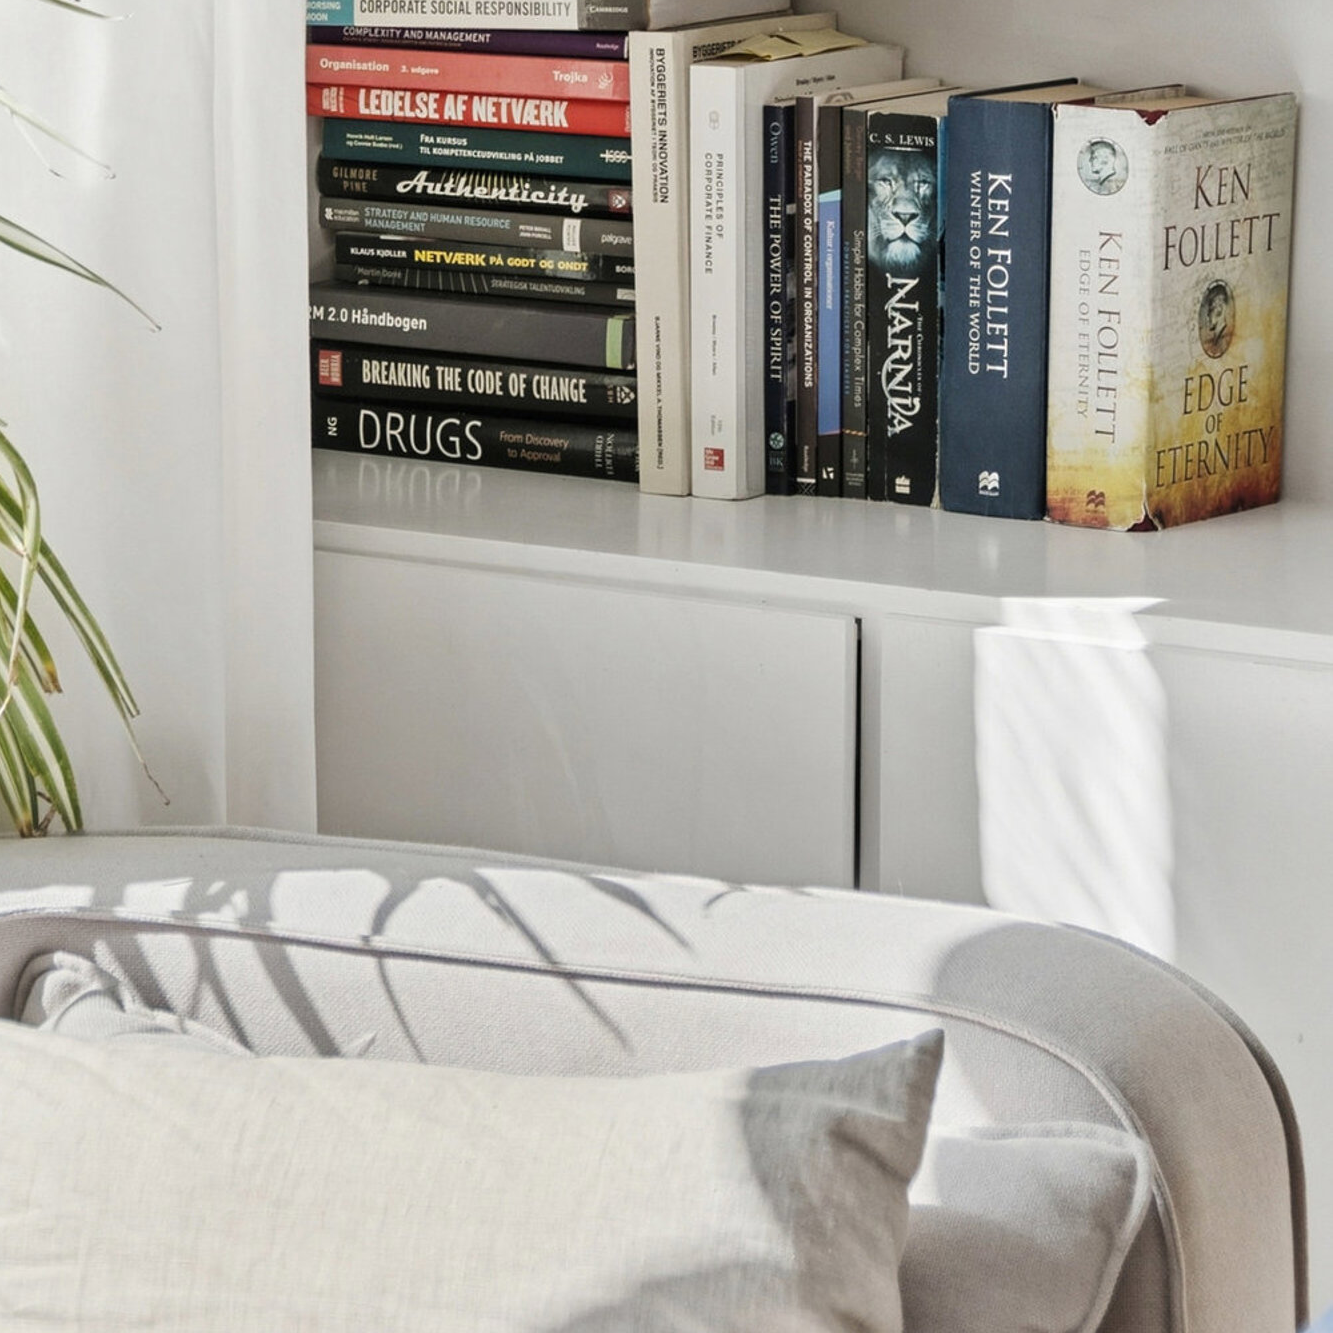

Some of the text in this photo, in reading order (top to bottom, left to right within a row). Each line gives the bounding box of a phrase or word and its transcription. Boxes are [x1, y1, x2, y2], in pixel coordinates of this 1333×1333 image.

[430, 0, 472, 17] SOCIAL
[475, 0, 572, 19] RESPONSIBILITY
[342, 26, 492, 44] COMPLEXITY AND MANAGEMENT
[319, 57, 390, 73] Organisation
[553, 70, 589, 85] Trojka
[358, 88, 570, 128] LEDELSE AF NETVÆRK
[657, 47, 669, 204] BYGGERIETS INNOVATION
[420, 133, 468, 147] FRA KURSUS
[396, 170, 589, 214] Authenticity
[1192, 161, 1252, 210] KEN
[364, 220, 426, 233] MANAGEMENT
[704, 152, 714, 274] CORPORATE FINANCE
[1162, 213, 1280, 272] FOLLETT
[768, 194, 783, 382] THE POWER OF SPIRIT
[968, 170, 982, 375] WINTER OF THE WORLD
[985, 171, 1013, 380] KEN FOLLETT
[327, 305, 427, 332] 2.0 Håndbogen
[1077, 249, 1091, 419] EDGE OF ETERNITY
[1094, 230, 1123, 445] KEN FOLLETT
[881, 272, 921, 439] NARNIA
[361, 359, 588, 404] BREAKING THE CODE OF CHANGE
[1182, 363, 1249, 415] EDGE
[358, 409, 483, 463] DRUGS
[500, 431, 570, 451] From Discovery
[1204, 411, 1224, 435] OF
[1155, 425, 1276, 489] ETERNITY
